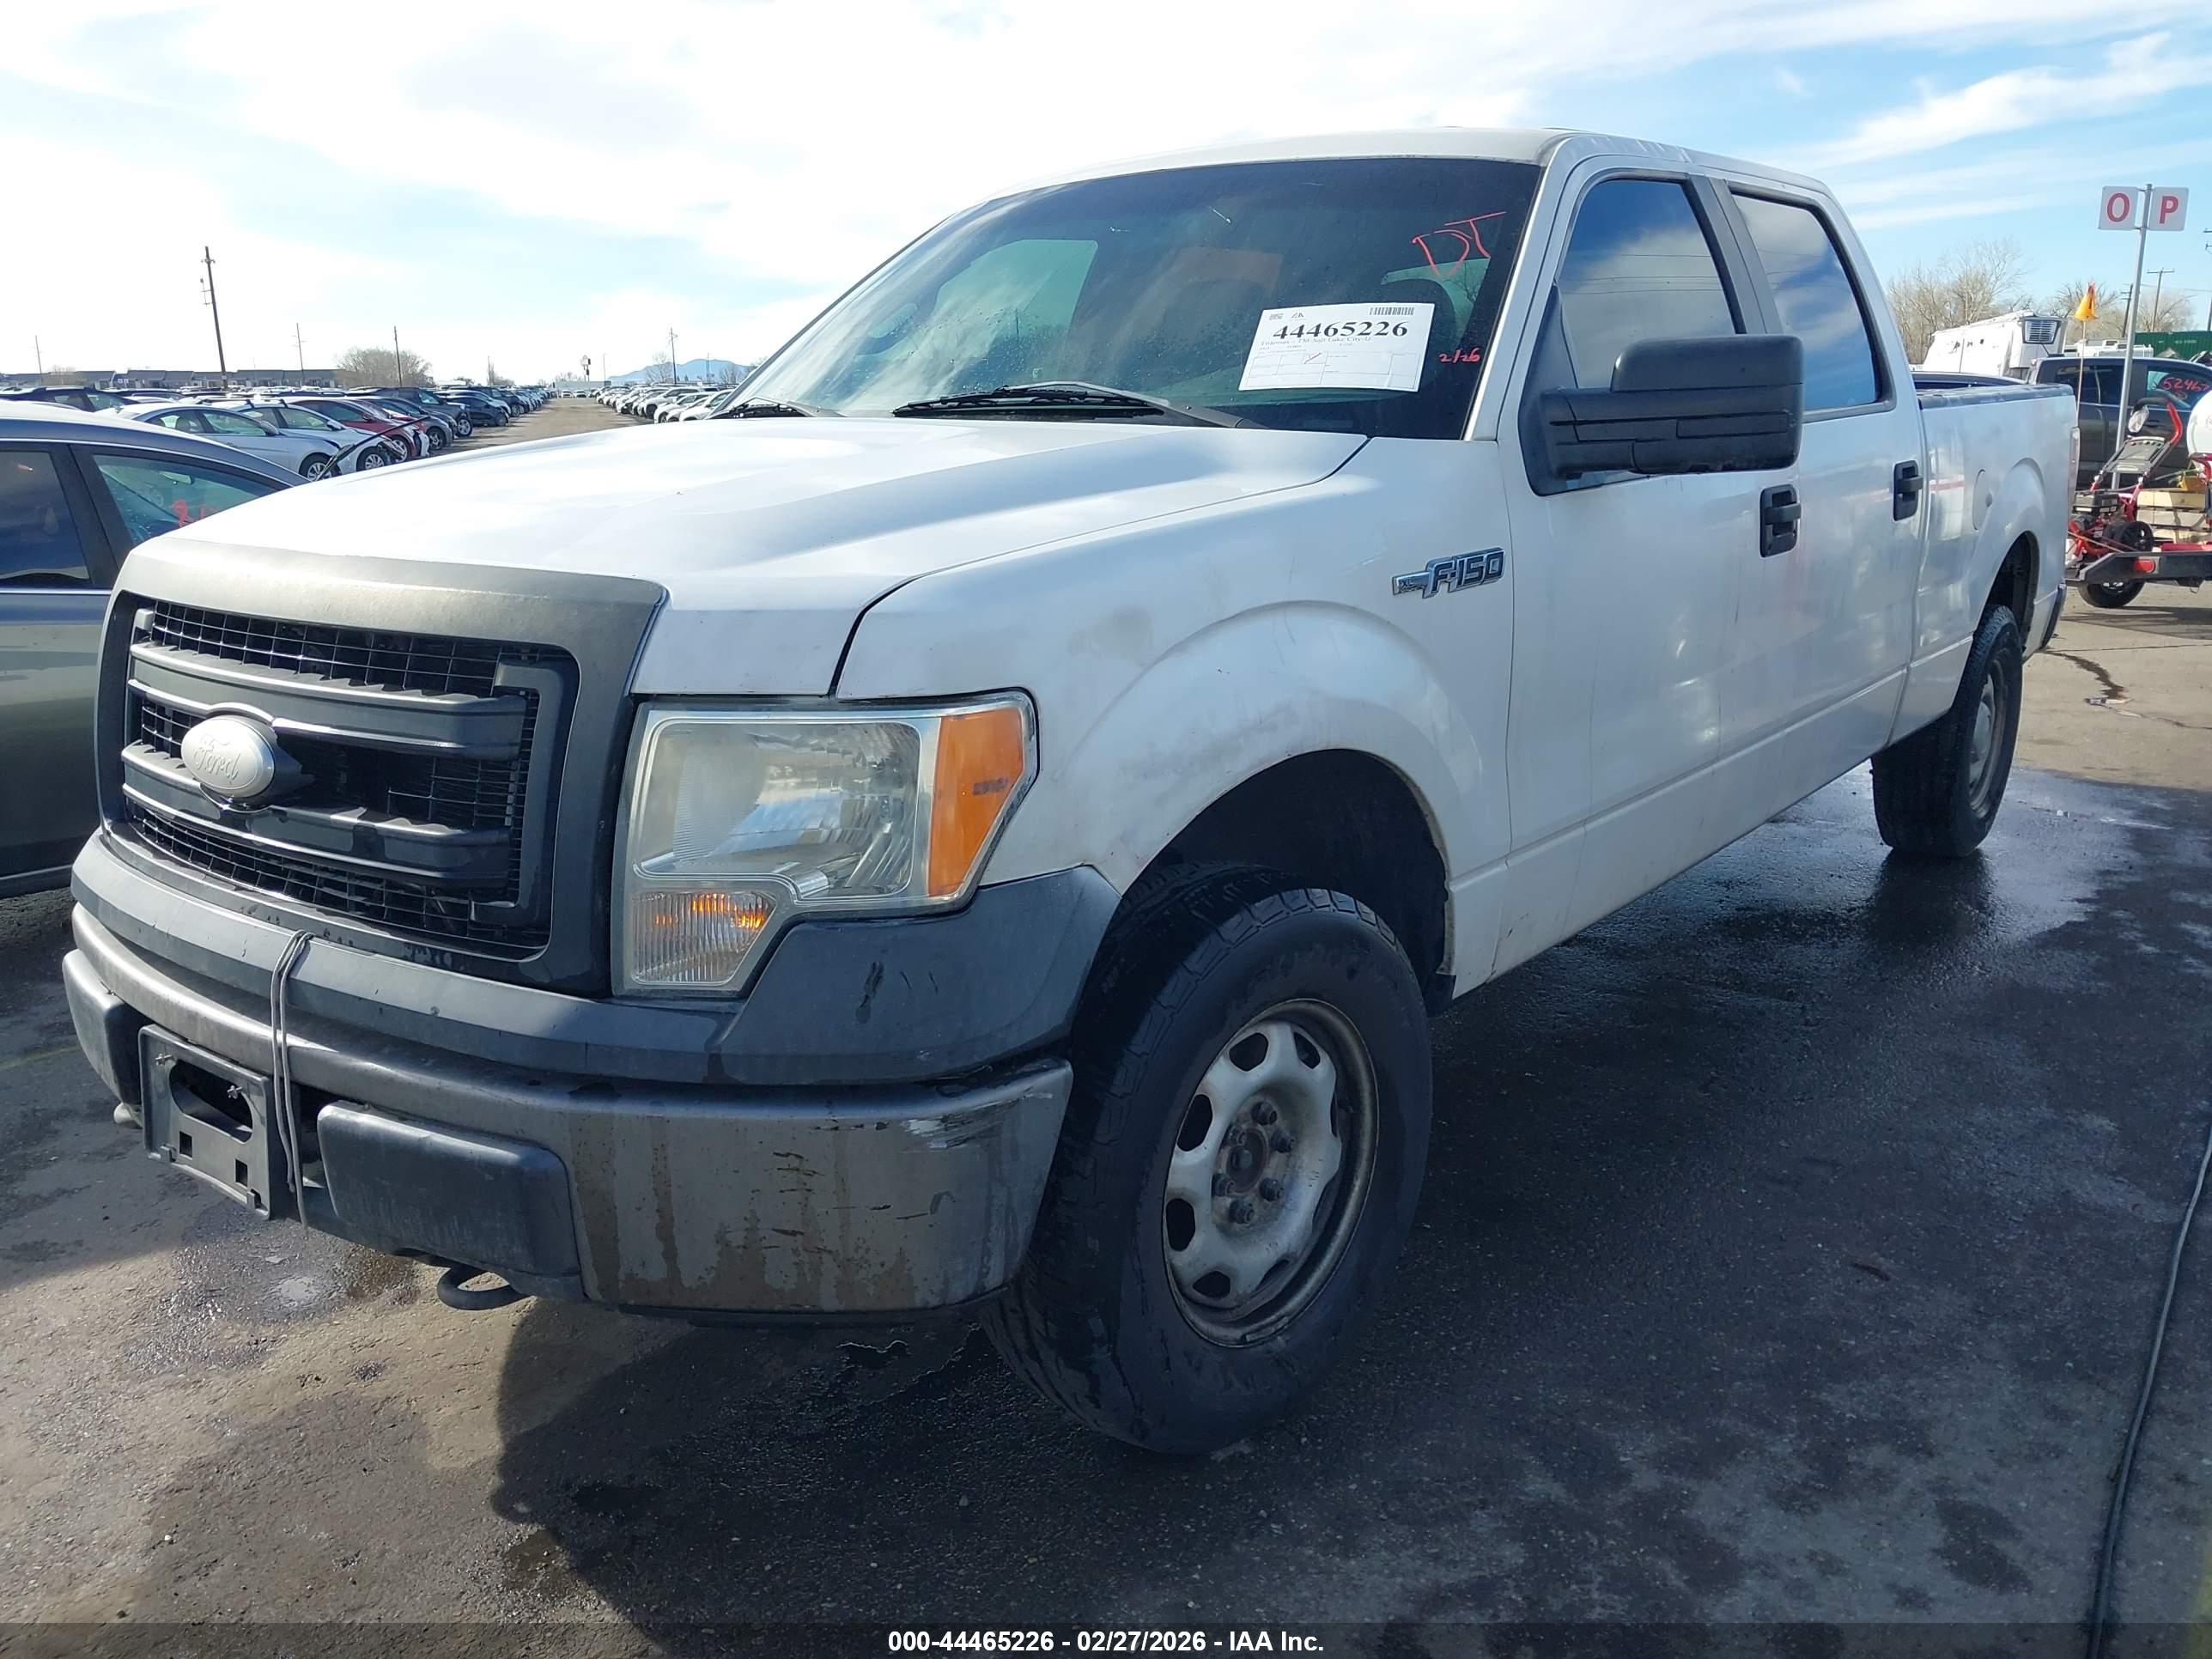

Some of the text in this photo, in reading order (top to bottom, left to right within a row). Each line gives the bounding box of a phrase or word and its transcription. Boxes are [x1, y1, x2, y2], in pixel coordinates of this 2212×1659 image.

[2106, 192, 2130, 222] O
[2159, 195, 2179, 224] P
[1273, 321, 1408, 339] 44465226
[193, 736, 241, 781] Ford
